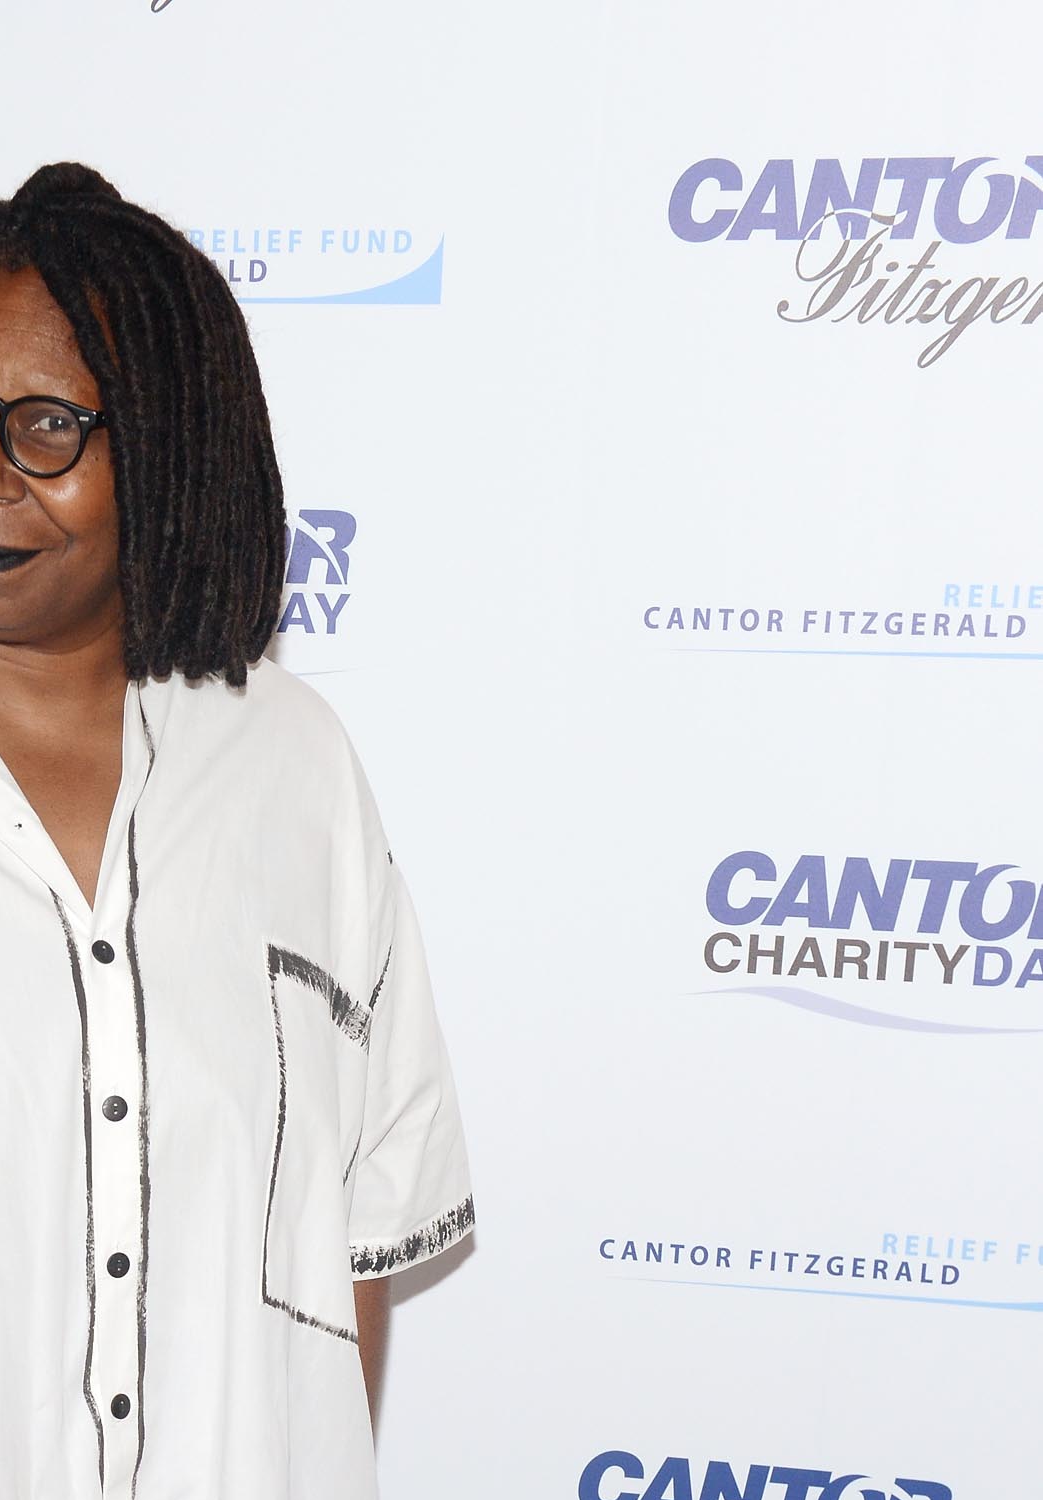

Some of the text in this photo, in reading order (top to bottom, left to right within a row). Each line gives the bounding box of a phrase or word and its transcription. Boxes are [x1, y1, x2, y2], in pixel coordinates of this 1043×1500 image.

[190, 229, 415, 254] RELIEF FUND
[644, 607, 1026, 638] CANTOR FITZGERALD
[706, 851, 1043, 941] CANTO
[599, 1238, 960, 1286] CANTOR FITZGERALD
[882, 1233, 998, 1262] RELIEF
